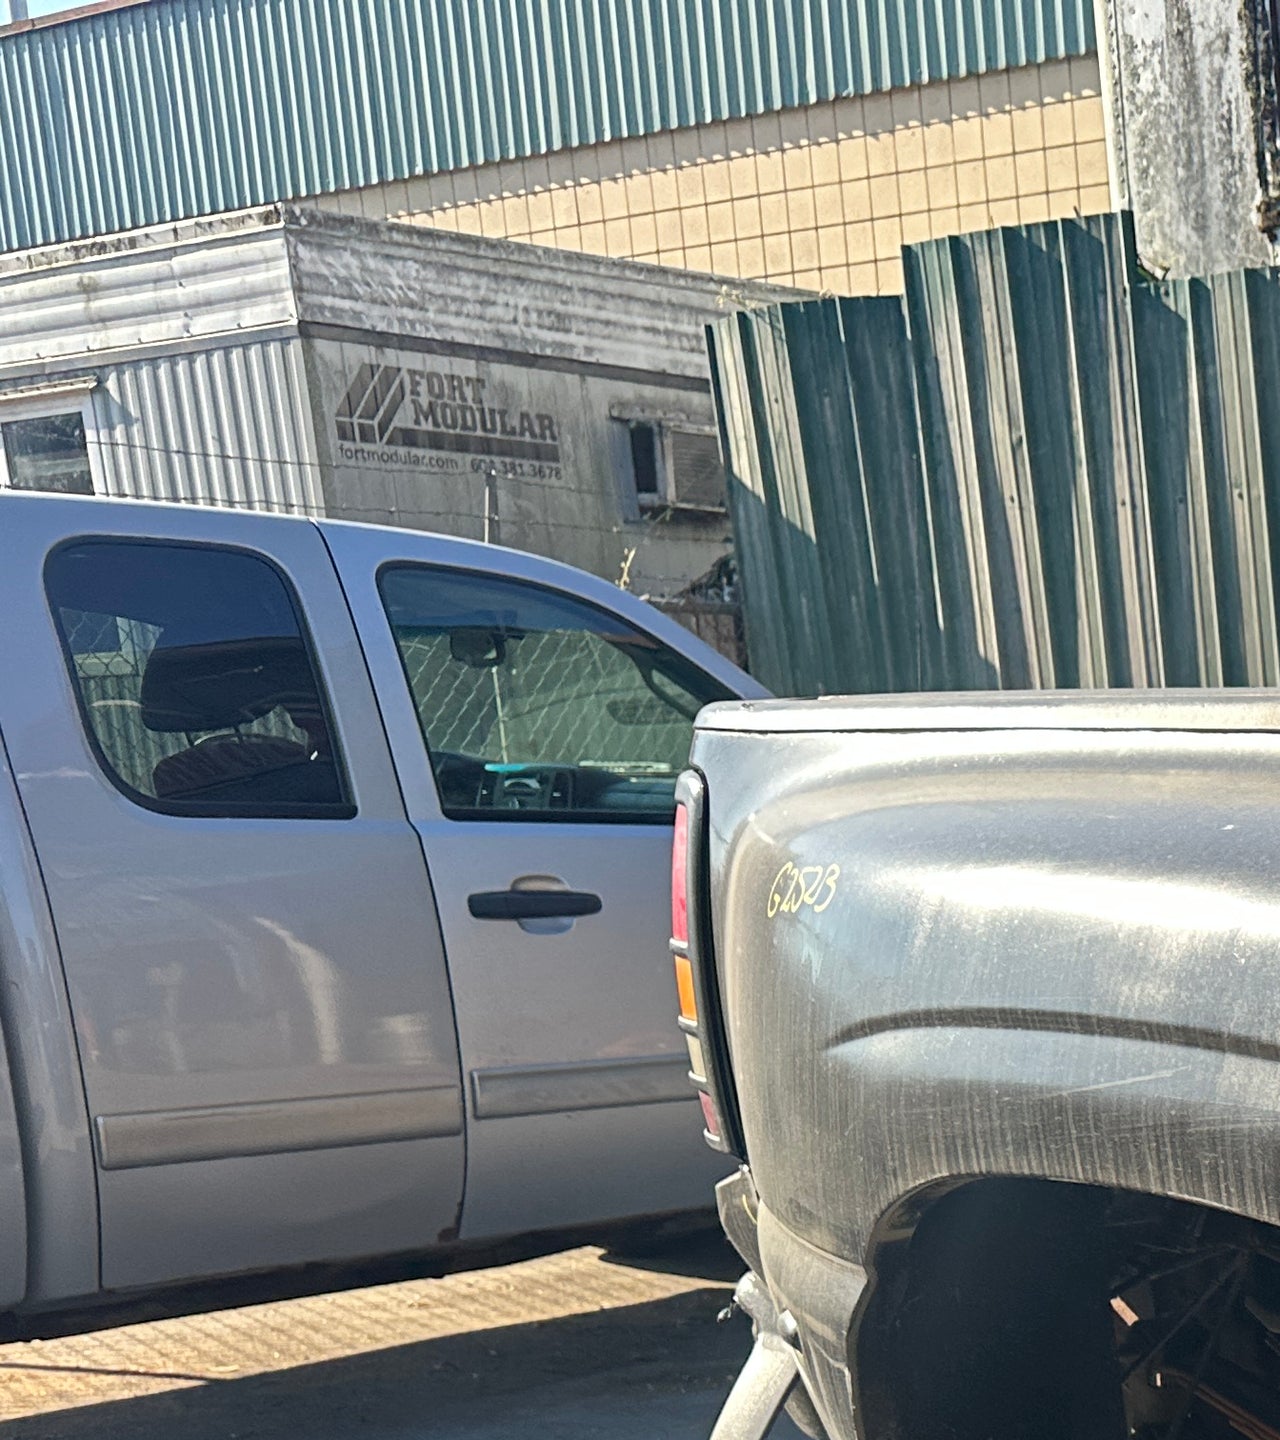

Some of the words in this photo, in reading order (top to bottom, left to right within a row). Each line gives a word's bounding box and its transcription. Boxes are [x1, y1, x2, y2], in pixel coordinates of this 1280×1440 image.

[408, 368, 486, 403] FORT
[411, 398, 558, 442] MODULAR
[339, 444, 459, 470] fortmodular.com
